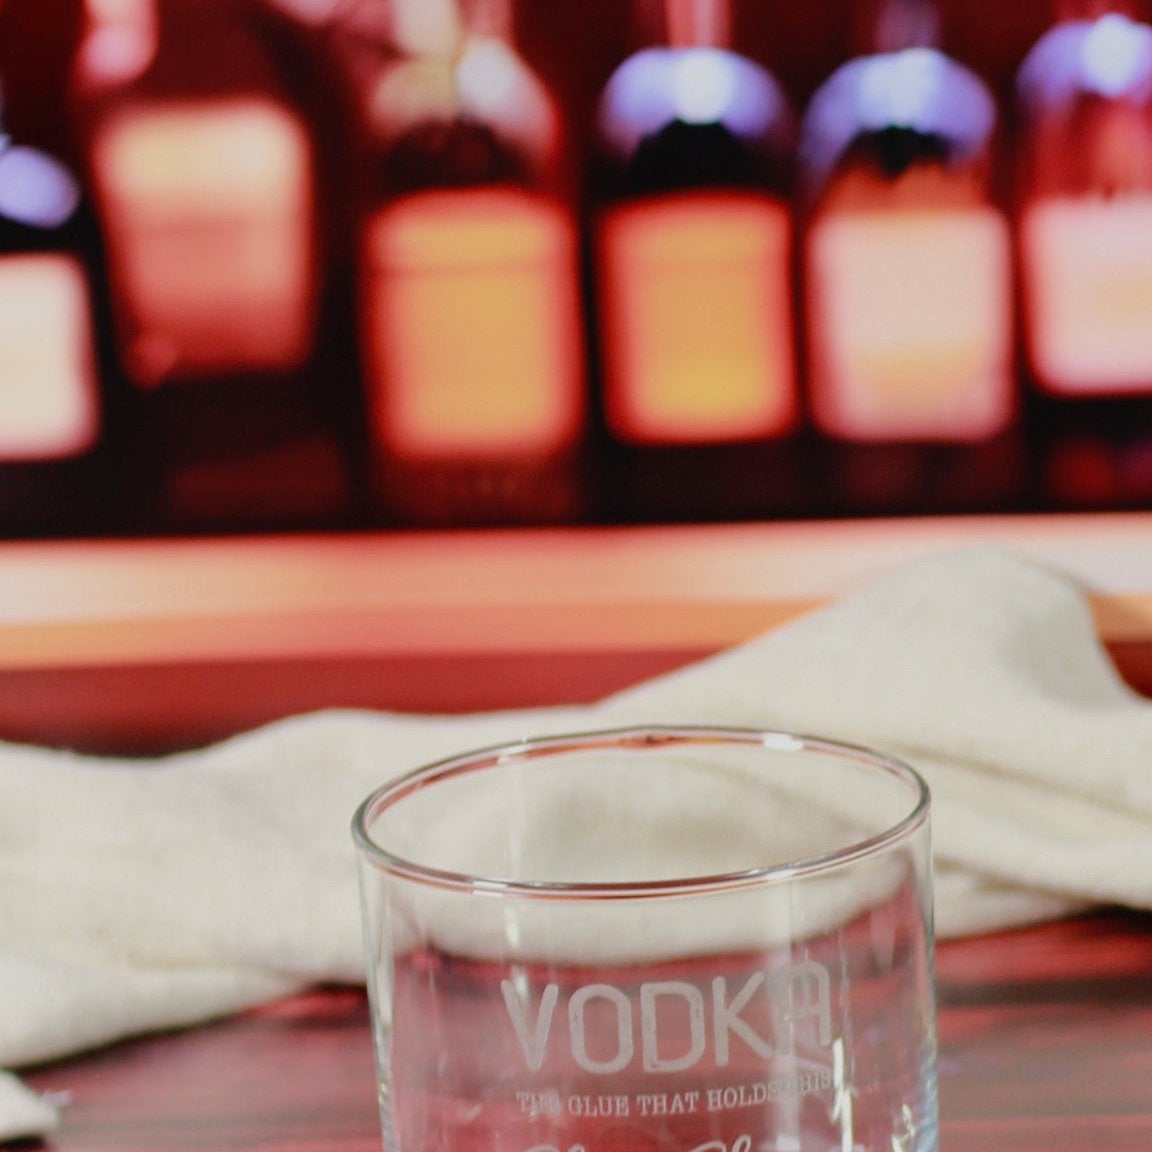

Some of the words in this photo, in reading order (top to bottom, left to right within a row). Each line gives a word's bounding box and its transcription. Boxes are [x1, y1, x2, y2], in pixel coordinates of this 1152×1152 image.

[500, 959, 832, 1075] VODKA
[567, 1093, 630, 1118] GLUE
[636, 1091, 700, 1117] THAT
